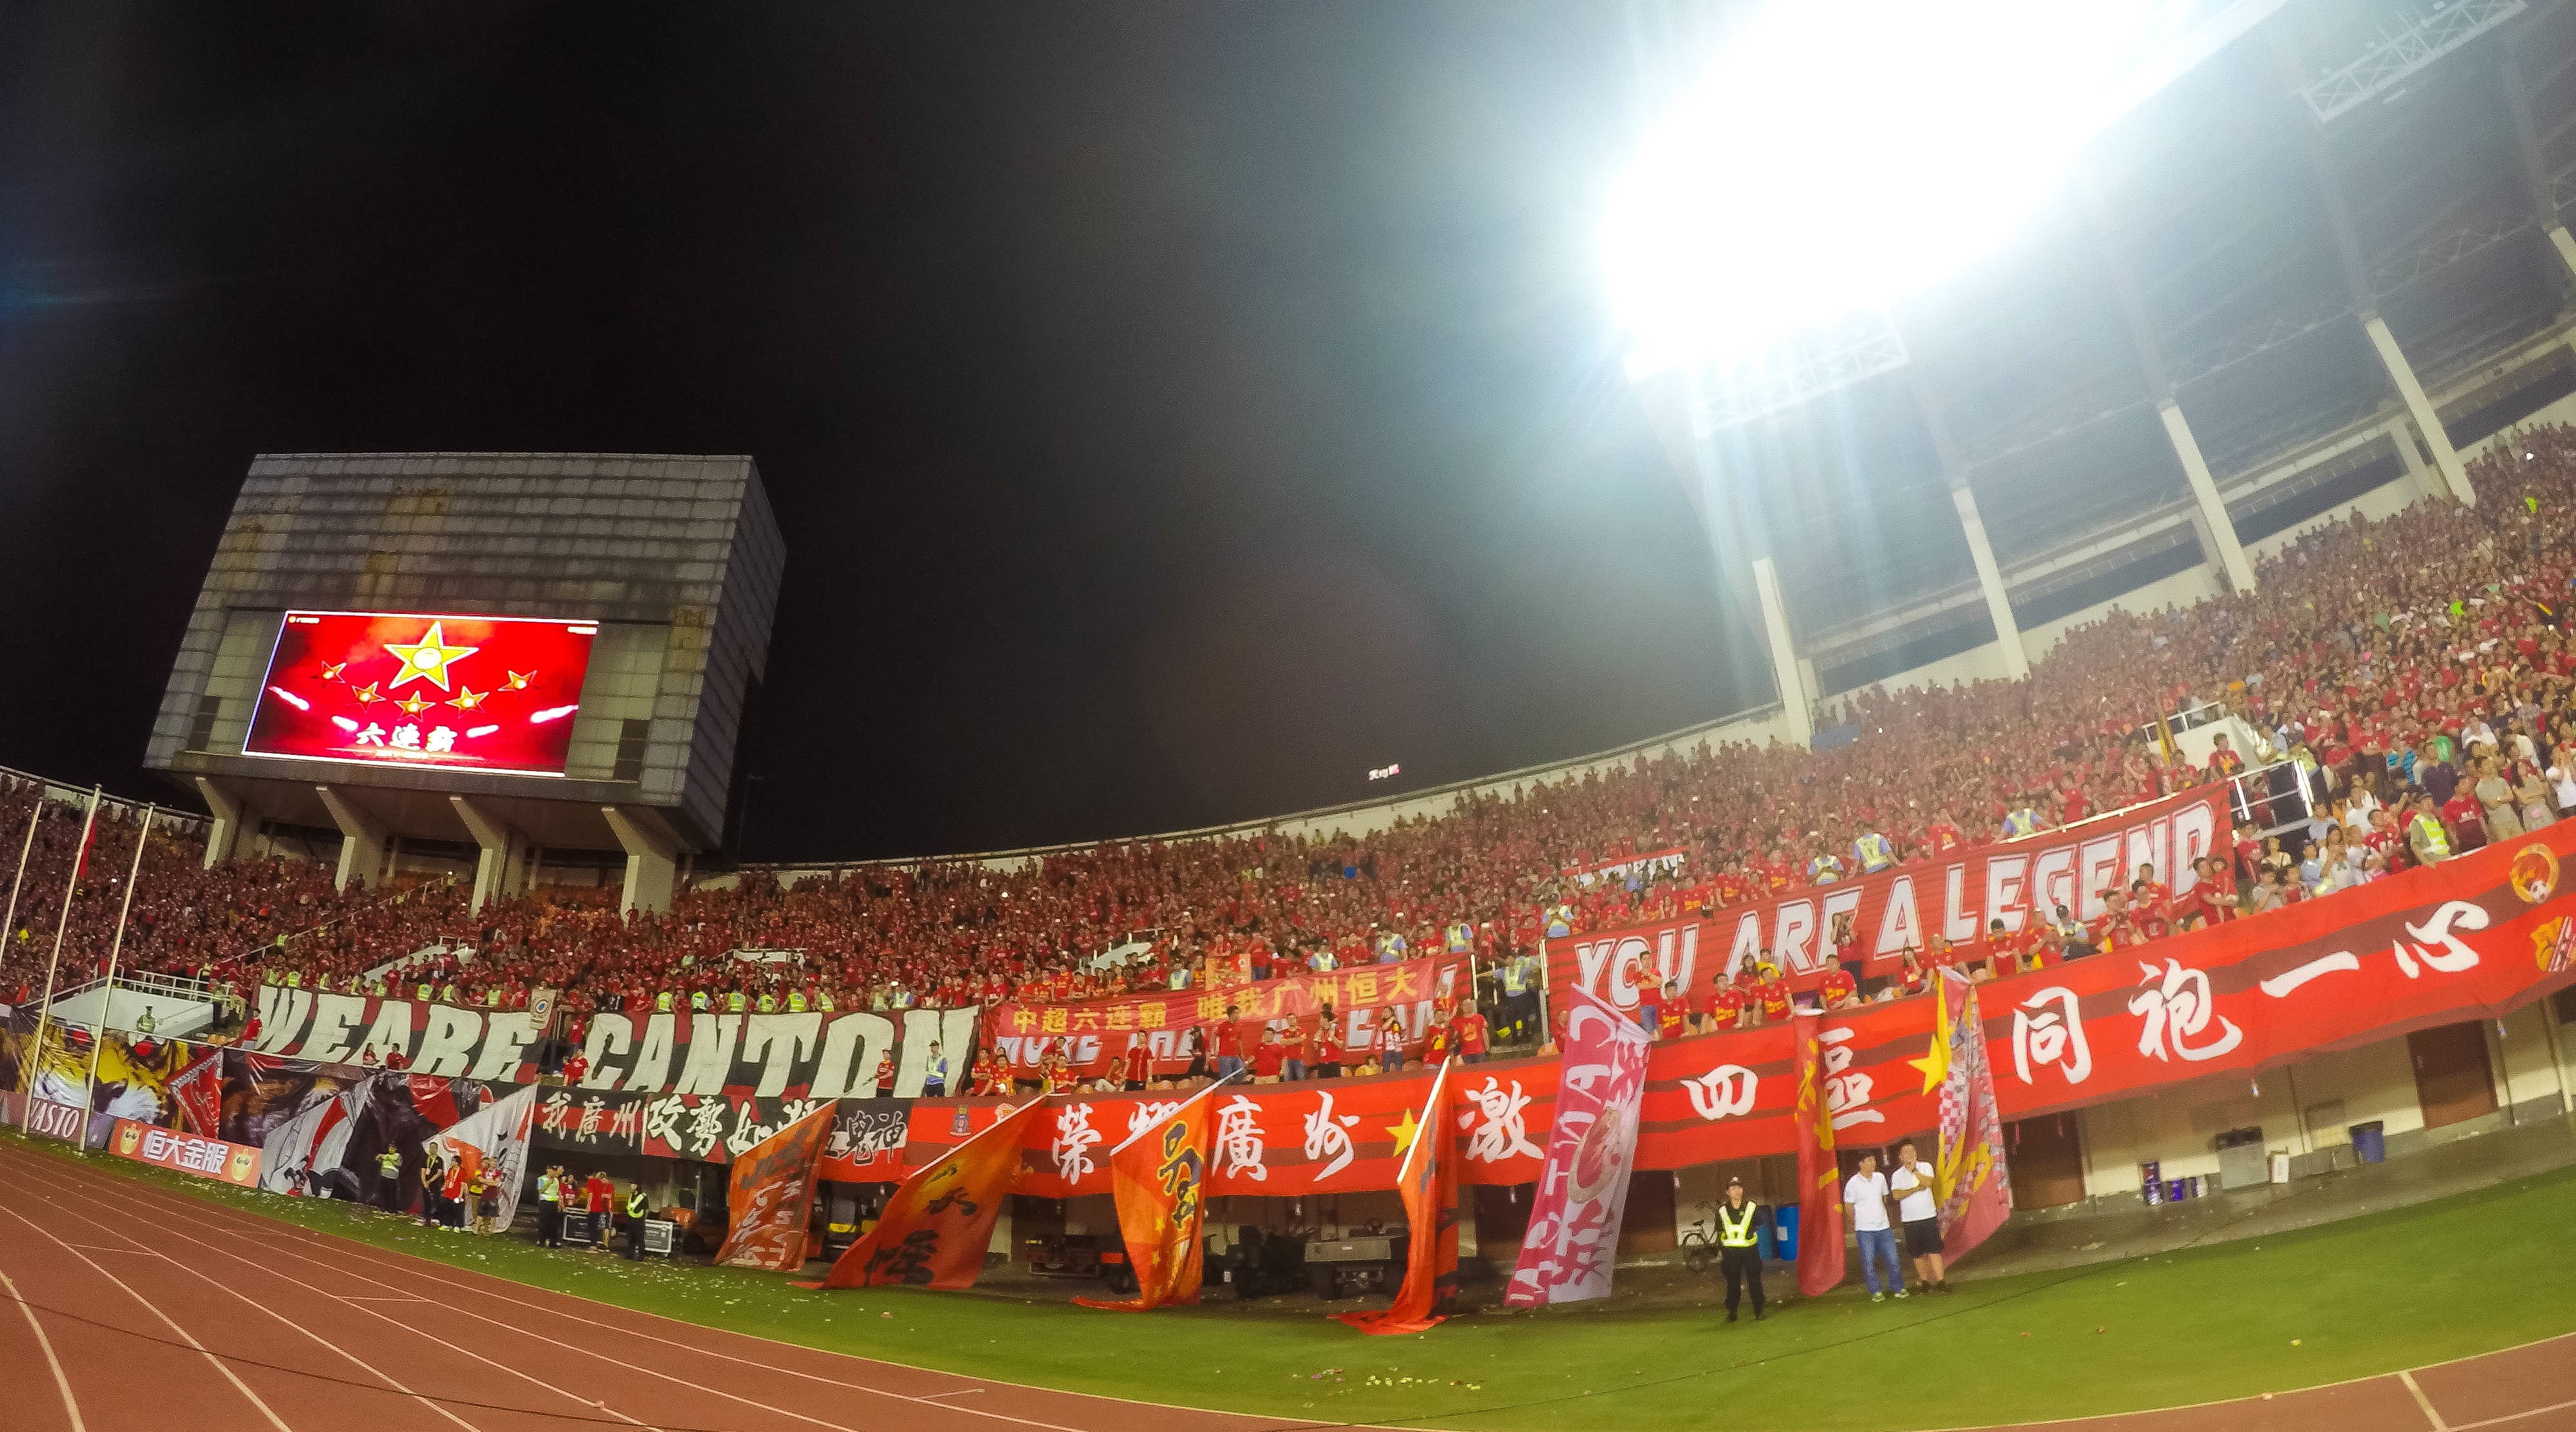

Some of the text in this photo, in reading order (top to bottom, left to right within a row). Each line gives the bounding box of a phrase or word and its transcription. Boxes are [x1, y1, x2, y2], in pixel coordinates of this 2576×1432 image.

[1575, 923, 1700, 1011] YOU
[1874, 875, 1924, 960] A
[1944, 799, 2214, 946] LEGEND
[577, 1005, 981, 1098] CANTON
[1458, 1027, 1886, 1163] 激四區
[2012, 900, 2492, 1085] 同袍一心
[142, 1129, 229, 1174] 恒大金服
